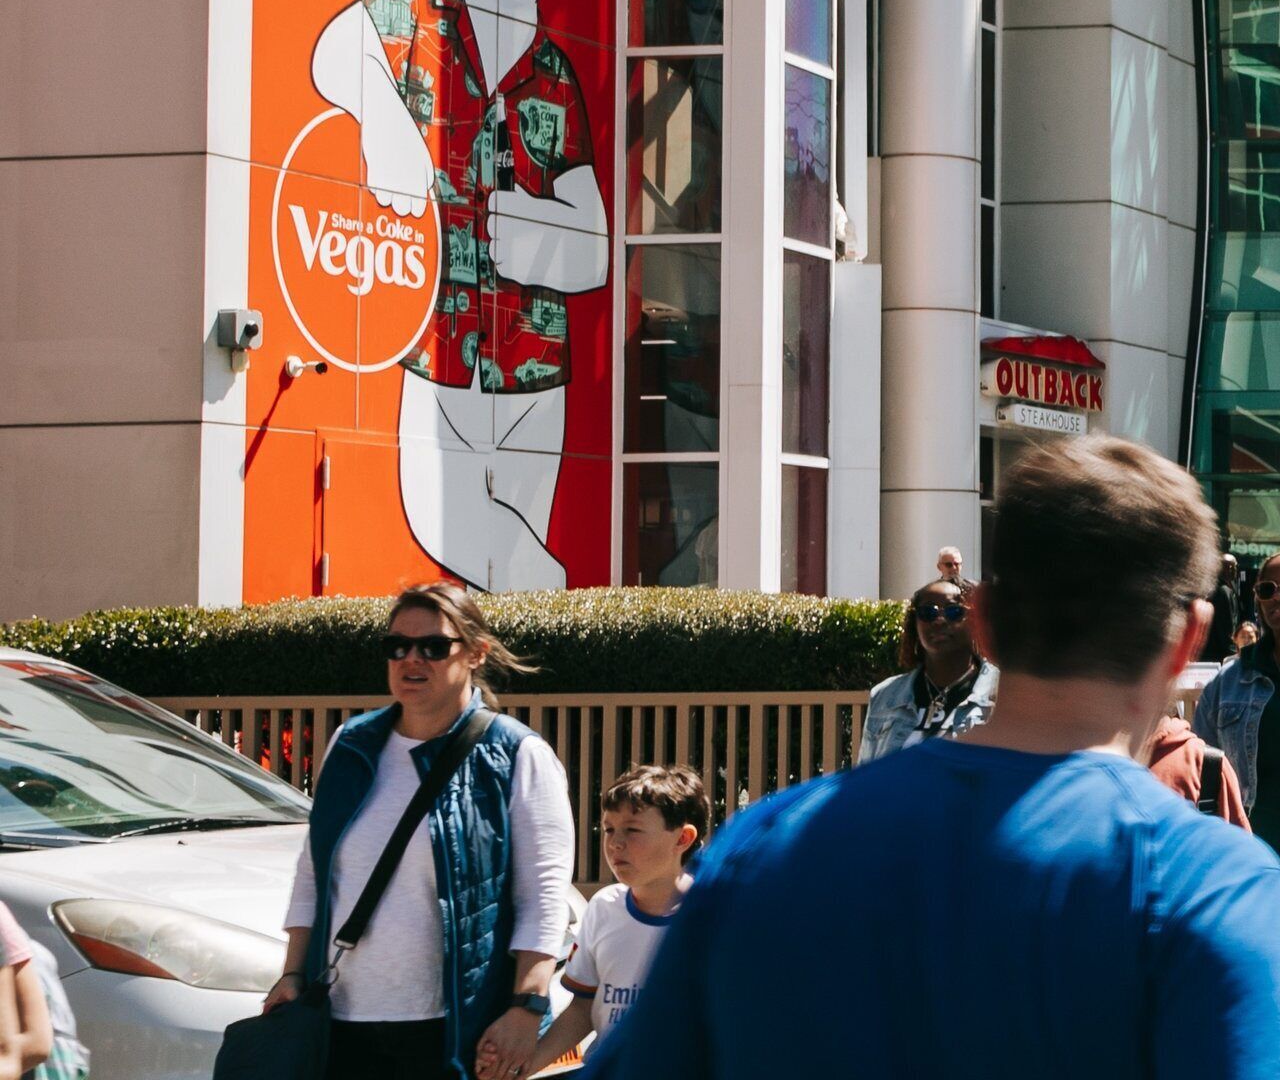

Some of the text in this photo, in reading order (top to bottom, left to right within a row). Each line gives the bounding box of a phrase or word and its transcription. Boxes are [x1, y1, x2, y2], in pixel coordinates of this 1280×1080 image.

[331, 213, 425, 244] Share a Coke in
[287, 204, 426, 297] Vegas
[995, 357, 1104, 413] OUTBACK
[1020, 407, 1081, 433] STEAKHOUSE
